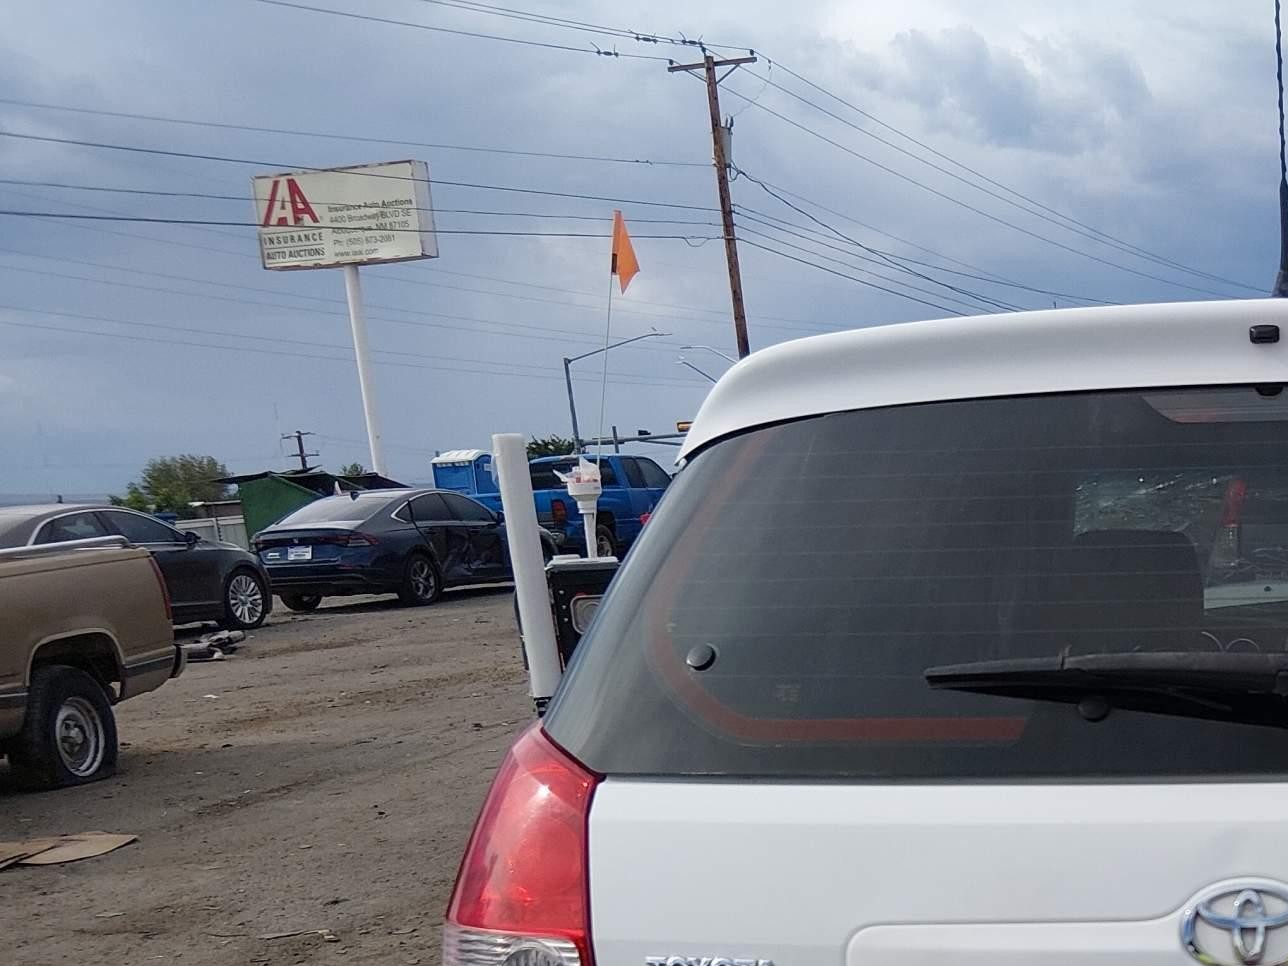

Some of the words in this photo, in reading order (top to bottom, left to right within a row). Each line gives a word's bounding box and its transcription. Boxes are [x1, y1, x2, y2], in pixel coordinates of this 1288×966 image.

[263, 231, 324, 246] INSURANCE
[266, 250, 288, 261] AUTO
[288, 246, 326, 259] AUCTIONS
